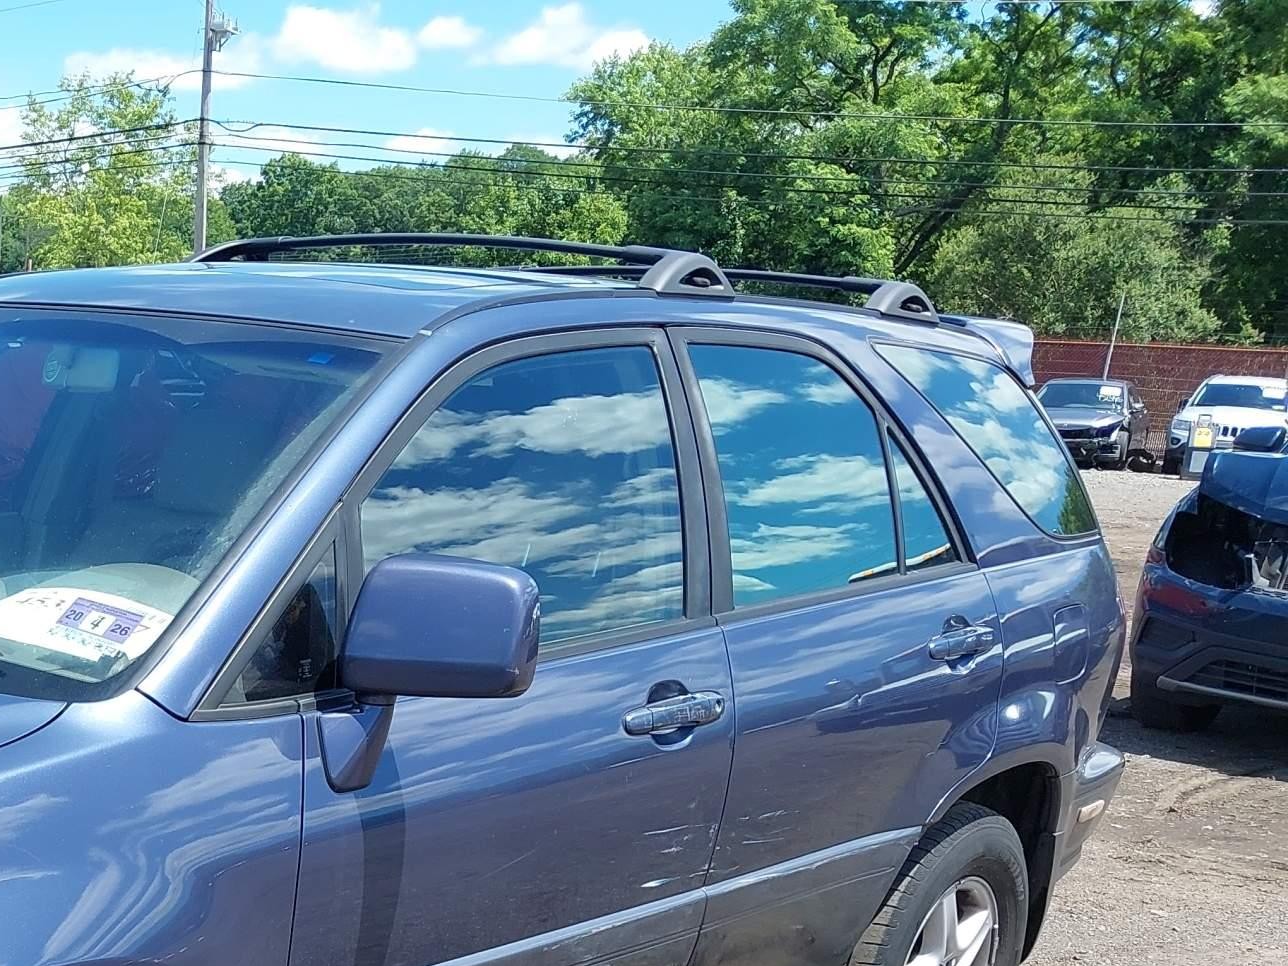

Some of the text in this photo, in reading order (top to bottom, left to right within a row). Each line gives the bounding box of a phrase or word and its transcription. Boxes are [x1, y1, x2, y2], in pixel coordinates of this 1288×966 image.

[65, 608, 85, 622] 20
[90, 616, 106, 630] 4
[109, 623, 131, 637] 26
